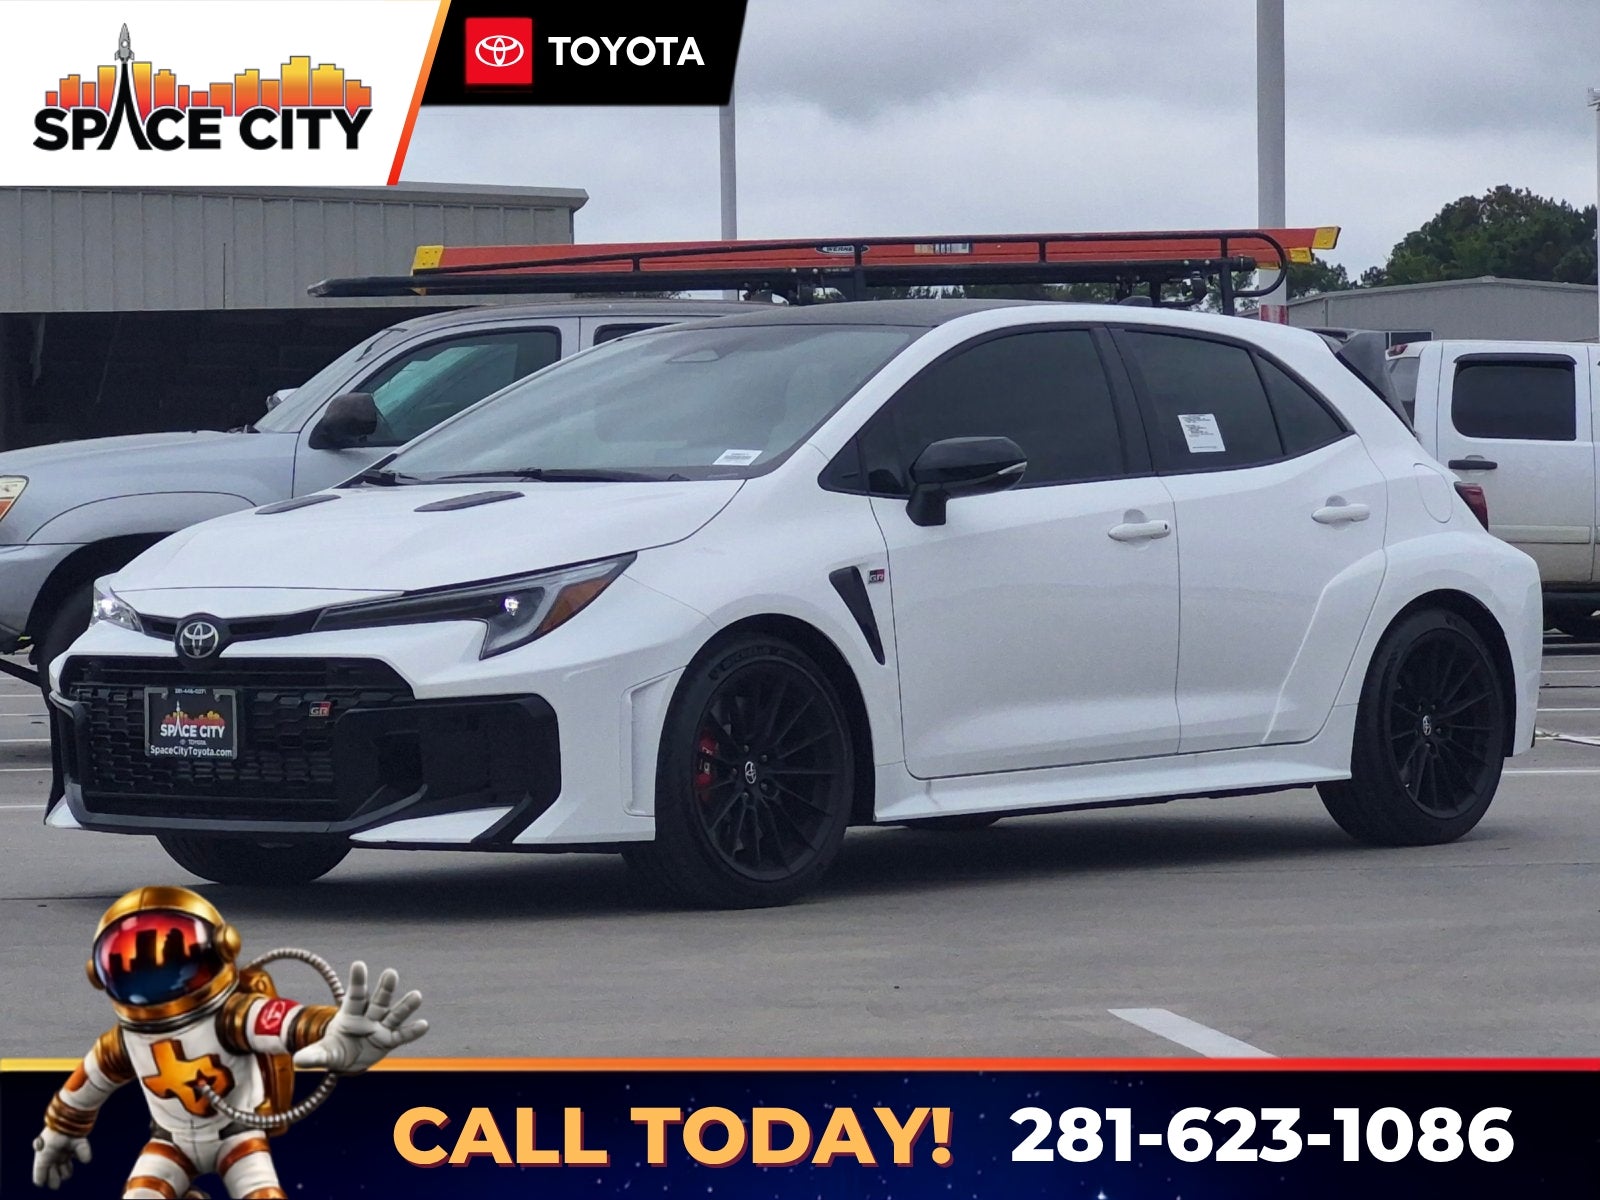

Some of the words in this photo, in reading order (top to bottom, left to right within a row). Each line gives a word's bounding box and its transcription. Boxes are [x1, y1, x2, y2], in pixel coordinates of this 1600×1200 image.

[160, 722, 198, 738] SPACE
[199, 725, 226, 739] CITY
[150, 745, 233, 758] SpaceCityToyota.com
